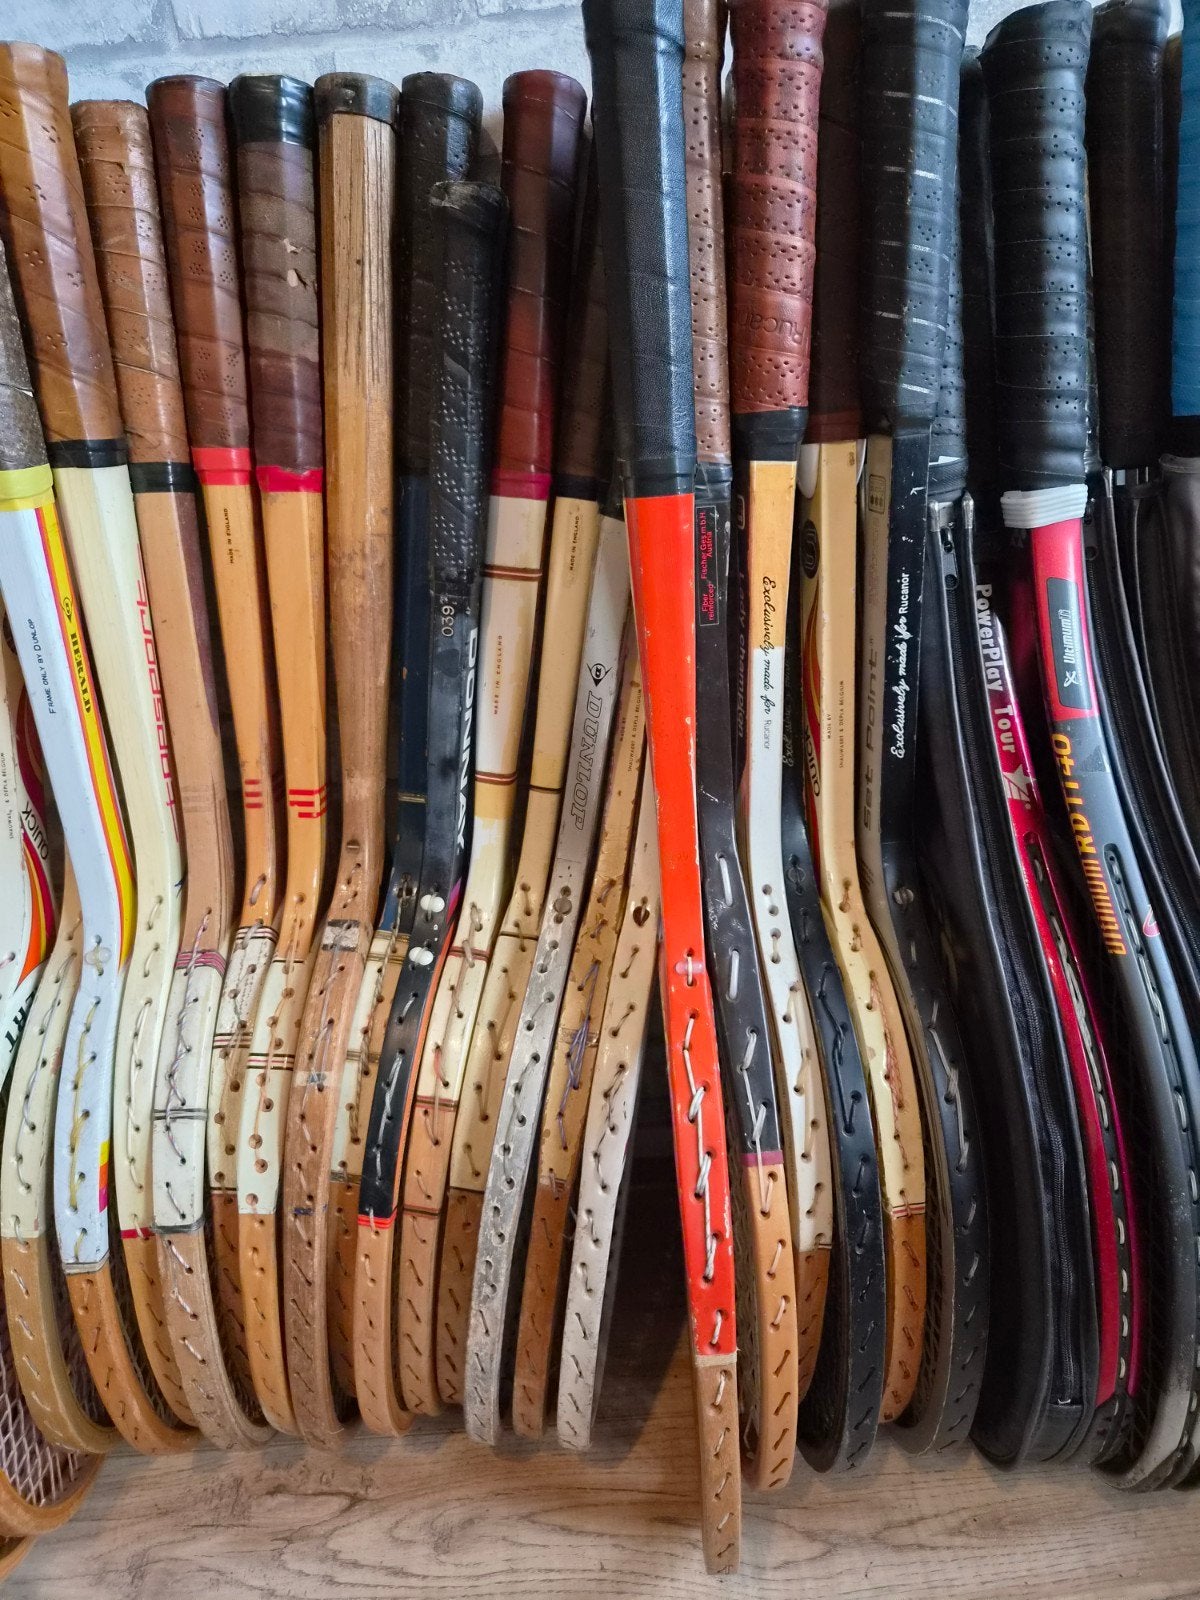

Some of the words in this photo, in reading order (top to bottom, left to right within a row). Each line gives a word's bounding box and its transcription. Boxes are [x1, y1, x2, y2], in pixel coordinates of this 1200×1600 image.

[760, 576, 776, 656] Exclusively
[898, 572, 910, 614] Rucanor
[28, 618, 42, 652] DUNLOP
[894, 616, 912, 640] for
[36, 654, 44, 664] BY
[40, 666, 49, 686] ONLY
[70, 632, 92, 714] HERALD
[763, 660, 774, 692] made
[895, 641, 908, 676] made
[976, 584, 1004, 692] PowerPlay
[994, 704, 1016, 754] Tour
[44, 688, 56, 714] FRAME
[760, 694, 775, 715] for
[866, 648, 878, 751] Point
[890, 678, 910, 758] Exclusively
[457, 627, 478, 852] DONNAY
[764, 720, 772, 749] Rucanor
[571, 690, 602, 831] DUNLOP
[804, 725, 821, 797] QUICK
[864, 764, 874, 832] Set
[21, 800, 50, 860] QUICK
